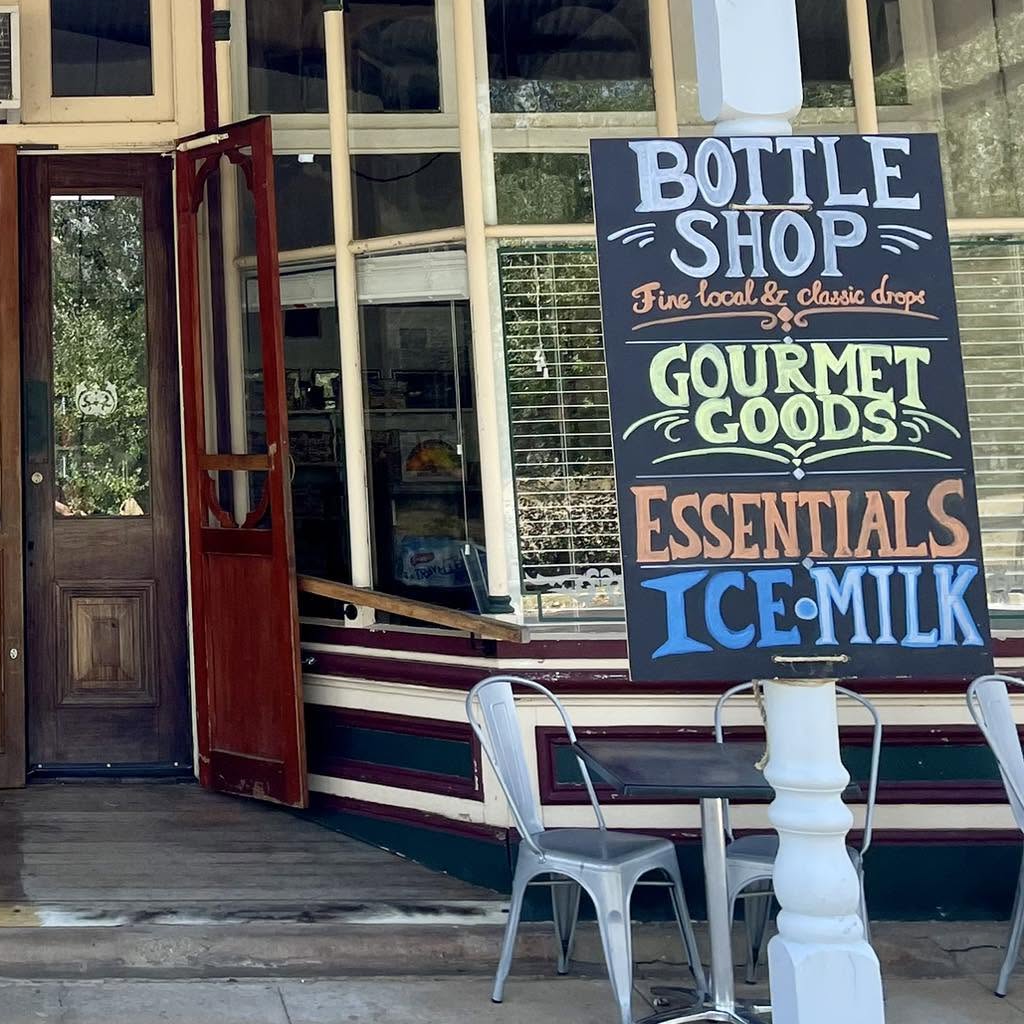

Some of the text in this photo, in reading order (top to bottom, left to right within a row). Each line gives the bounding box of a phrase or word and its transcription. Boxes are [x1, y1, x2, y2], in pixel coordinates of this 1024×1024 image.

[628, 136, 921, 212] BOTTLE
[670, 209, 868, 278] SHOP
[632, 273, 926, 314] Fine local & classic drops
[649, 341, 931, 409] GOURMET
[695, 393, 897, 444] GOODS
[629, 478, 970, 563] ESSENTIALS
